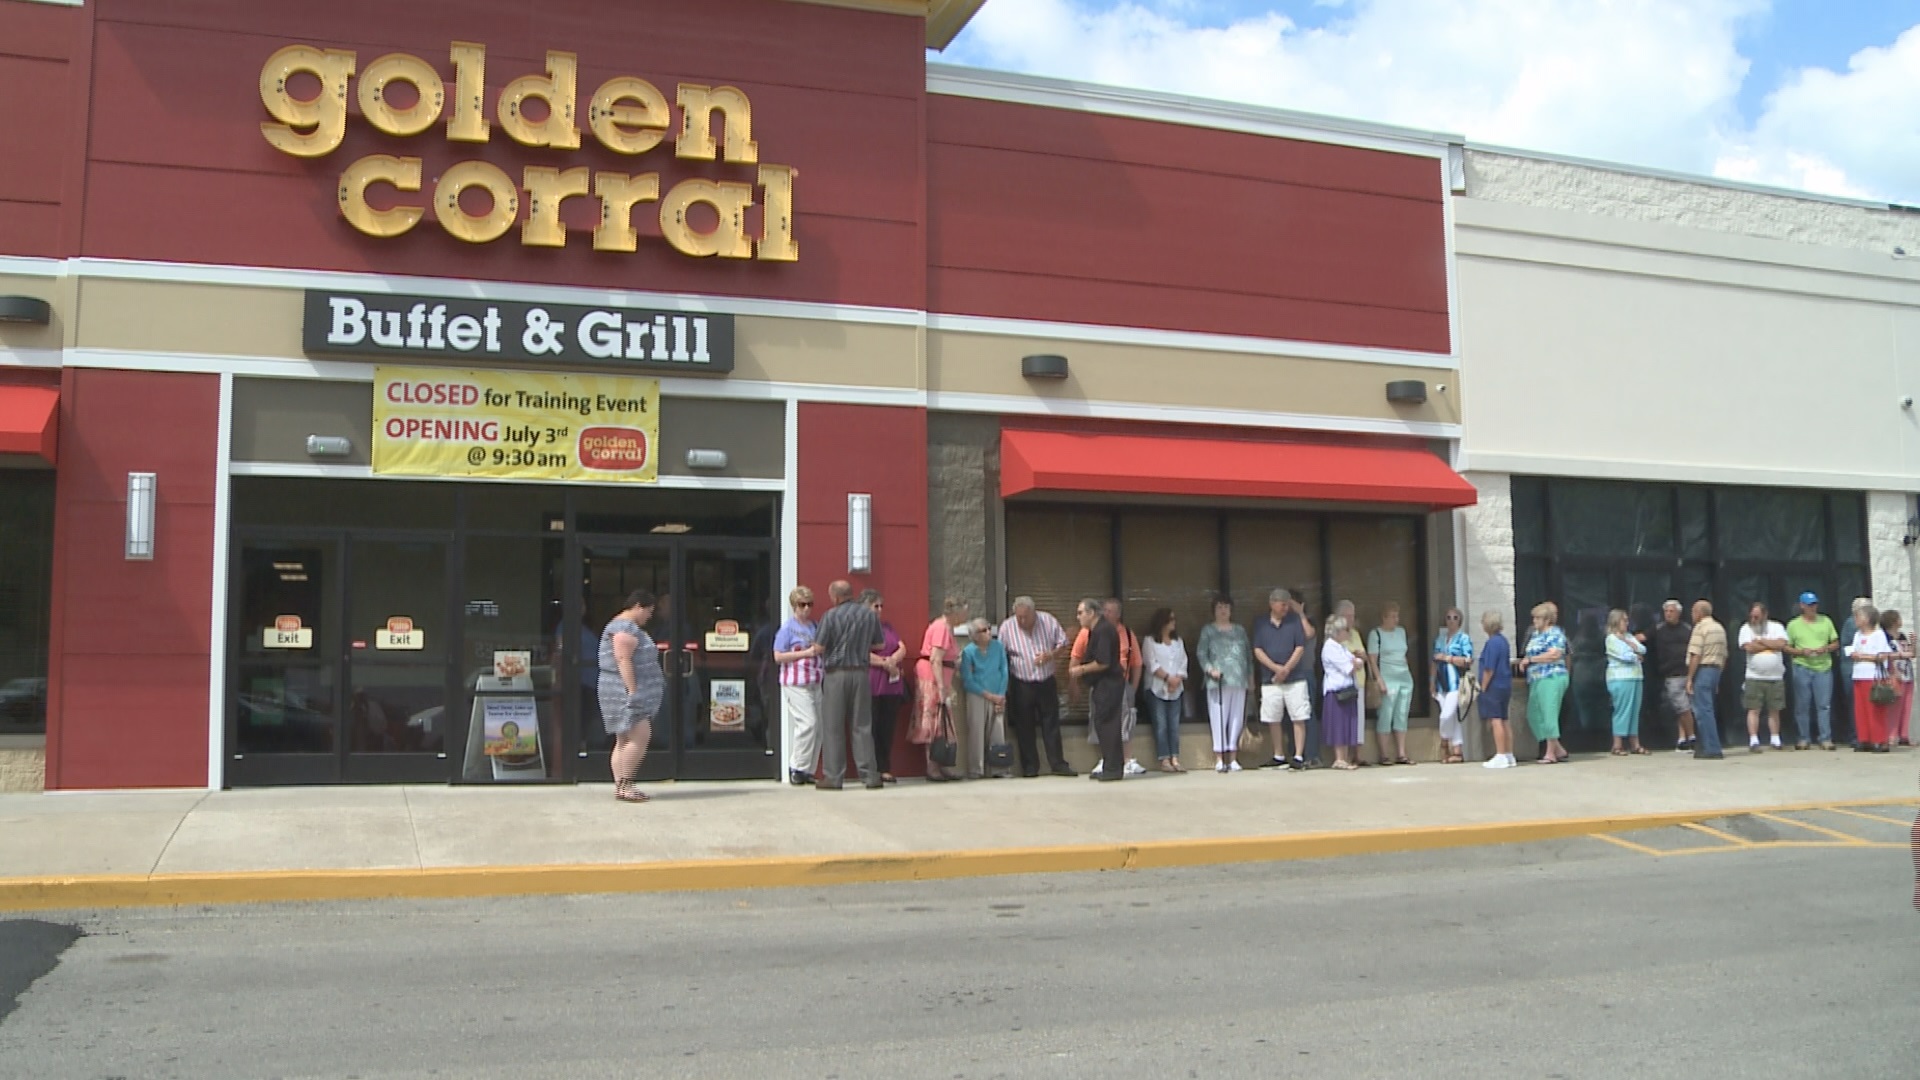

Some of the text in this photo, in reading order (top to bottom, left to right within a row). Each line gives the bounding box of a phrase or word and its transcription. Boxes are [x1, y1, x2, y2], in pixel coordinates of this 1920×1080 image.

[259, 40, 758, 164] golden
[337, 153, 799, 262] corral
[327, 297, 711, 364] Buffet & Grill
[386, 381, 647, 416] CLOSED for Training Event
[385, 417, 569, 448] OPENING July 3rd
[583, 435, 636, 451] golden
[467, 446, 486, 465] @
[591, 447, 642, 461] corral
[277, 632, 299, 643] Exit
[390, 634, 411, 645] Exit
